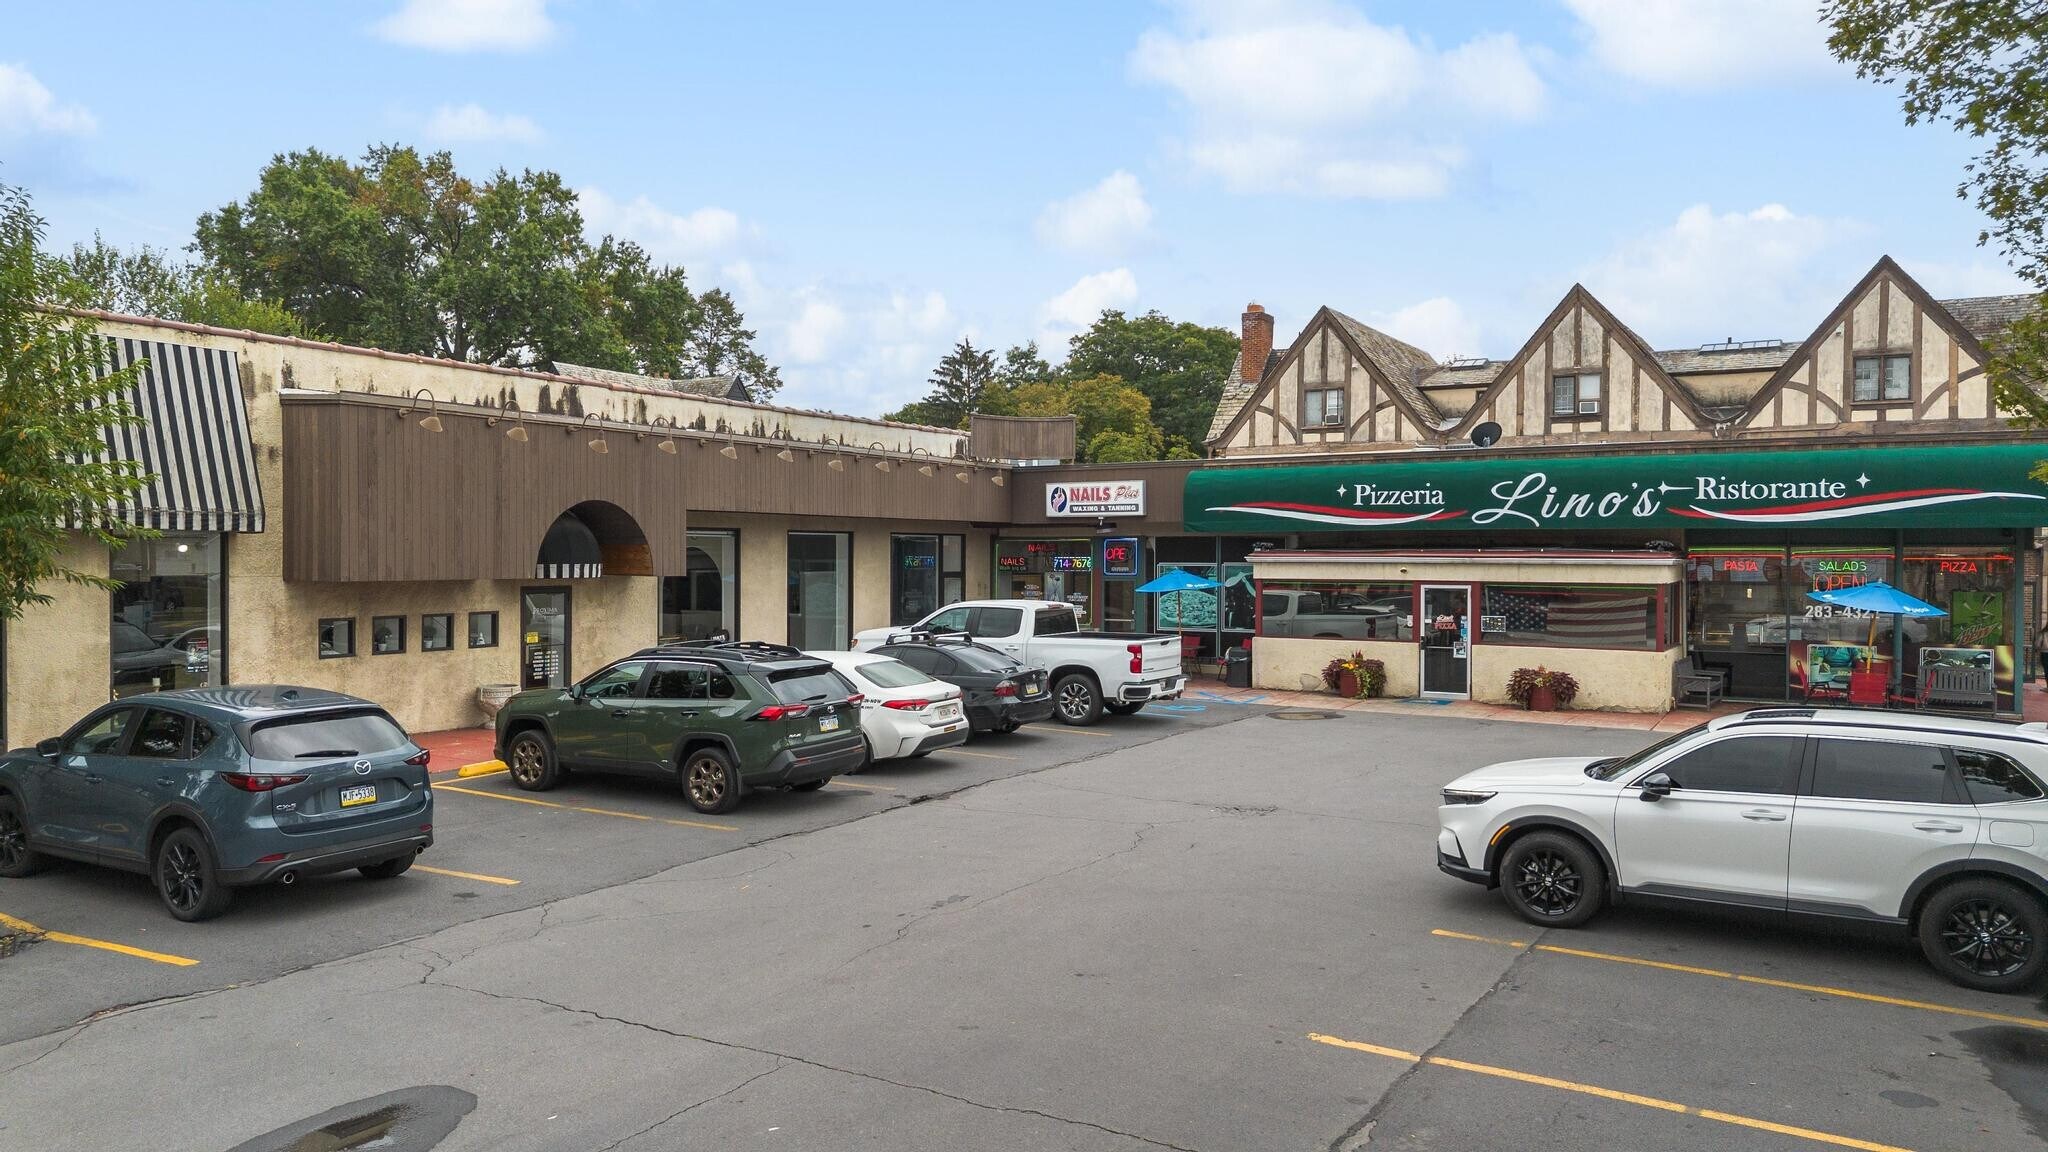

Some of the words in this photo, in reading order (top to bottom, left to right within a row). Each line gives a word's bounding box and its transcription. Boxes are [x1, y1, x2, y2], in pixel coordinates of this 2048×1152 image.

[1070, 486, 1111, 502] NAILS
[1114, 486, 1139, 501] Plus
[1353, 482, 1446, 506] Pizzeria
[1471, 472, 1660, 528] Lino's
[1694, 476, 1847, 501] Ristorante
[1000, 557, 1025, 566] NAILS
[1053, 558, 1091, 568] 714-7676
[1723, 560, 1759, 572] PASTA
[1819, 561, 1867, 572] SALADS
[1940, 561, 1978, 573] PIZZA
[1815, 574, 1865, 592] OPEN
